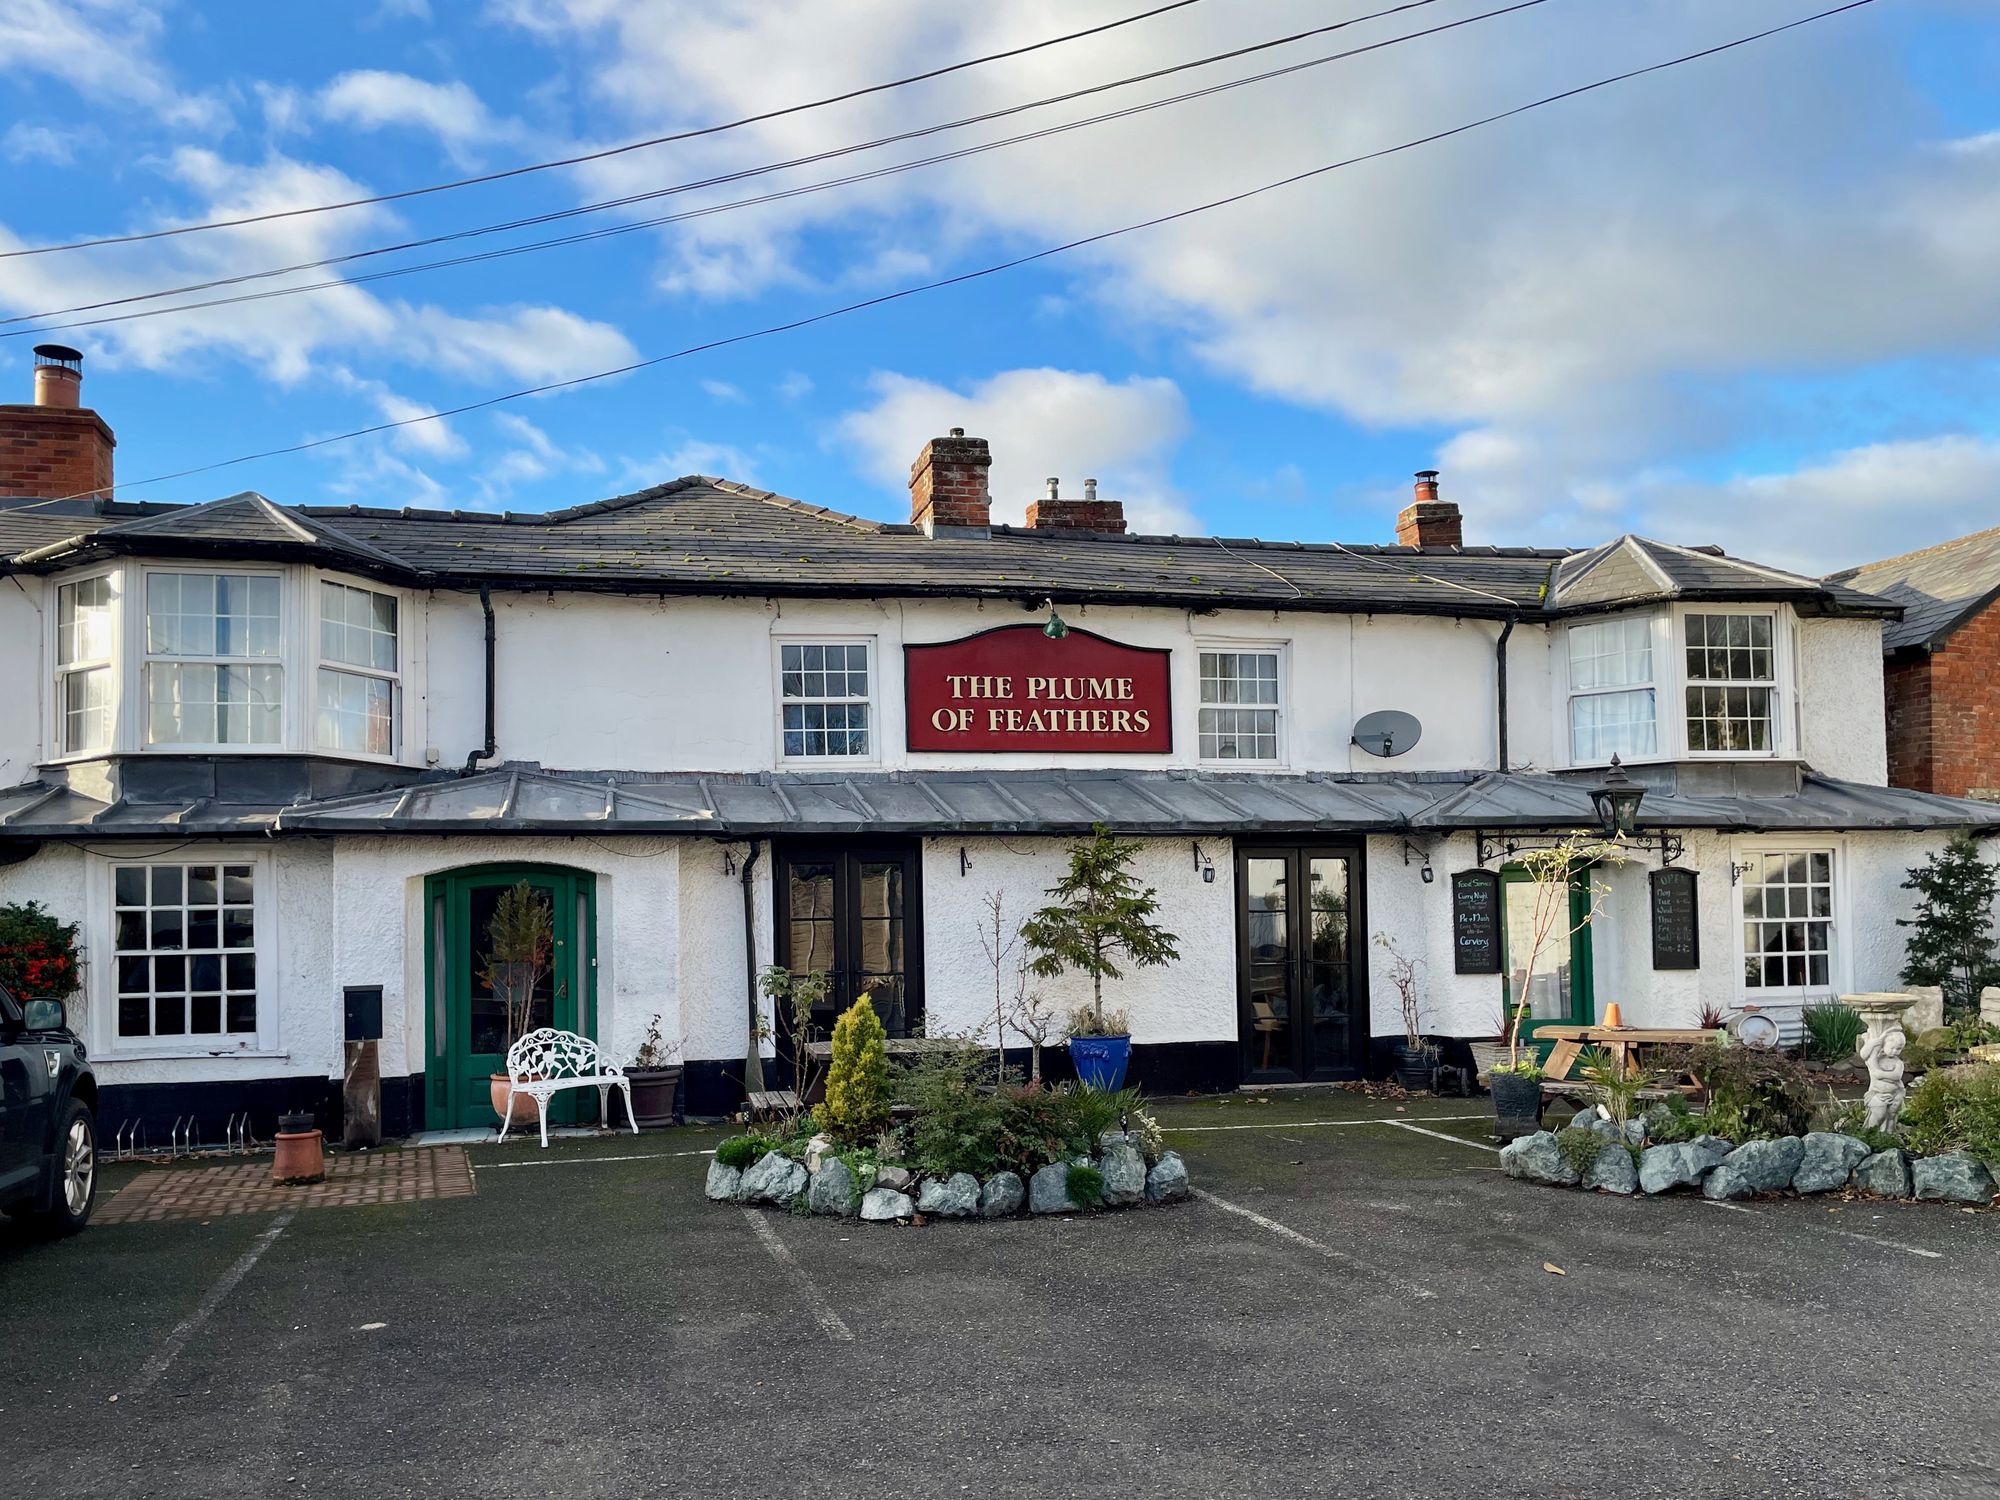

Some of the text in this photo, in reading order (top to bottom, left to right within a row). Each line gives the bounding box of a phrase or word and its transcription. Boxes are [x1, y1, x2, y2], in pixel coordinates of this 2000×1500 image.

[946, 675, 1135, 700] THE PLUME
[931, 708, 1150, 732] OF FEATHERS
[1457, 892, 1474, 902] Curry
